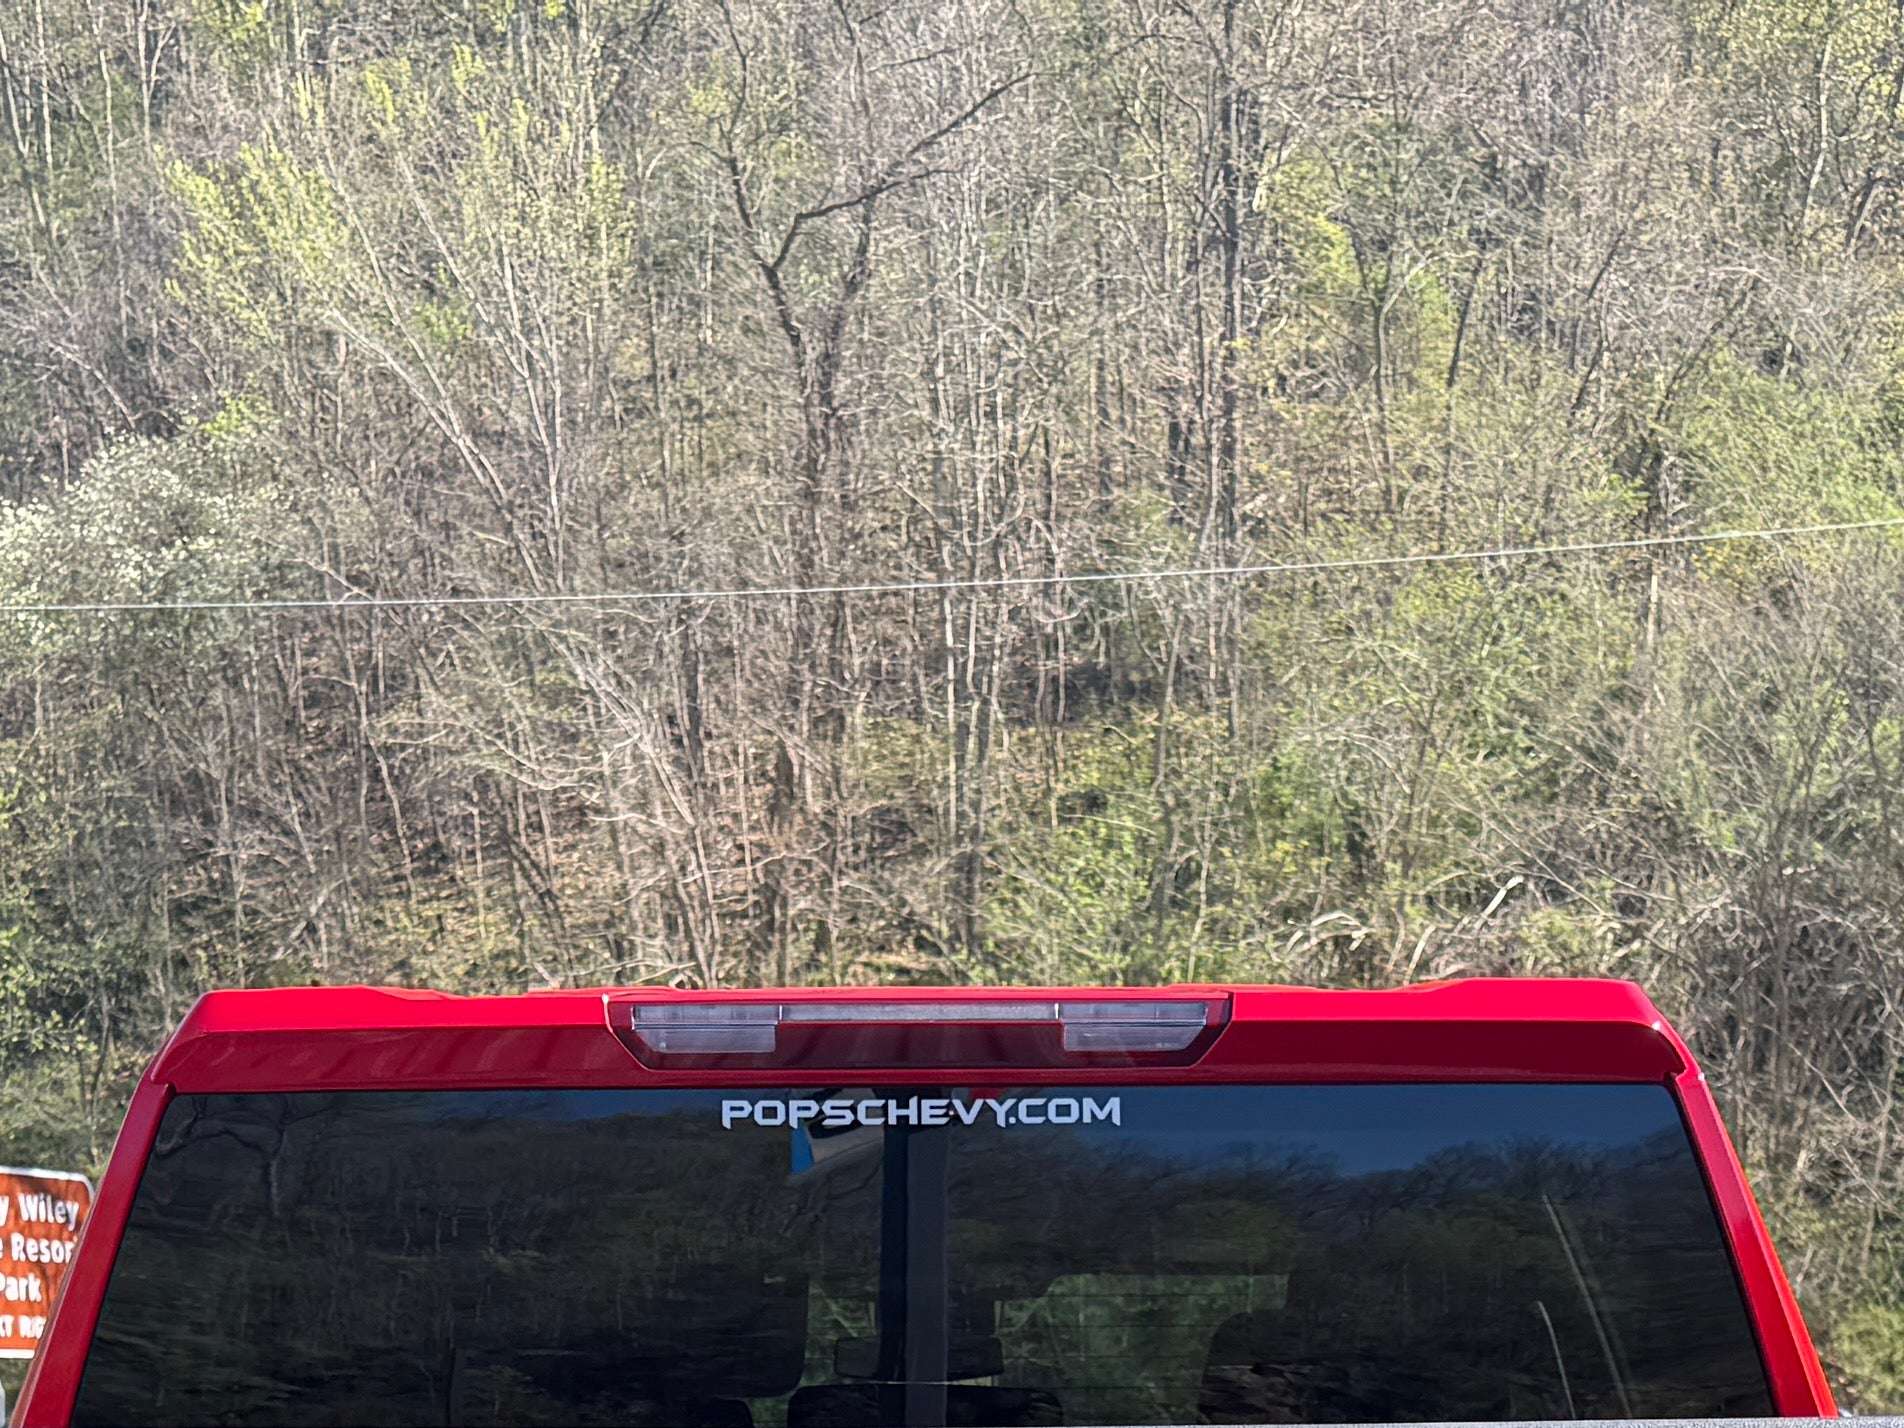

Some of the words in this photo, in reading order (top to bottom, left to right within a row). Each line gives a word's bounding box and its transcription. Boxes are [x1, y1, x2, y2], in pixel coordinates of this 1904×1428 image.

[721, 1096, 1121, 1130] POPSCHEVY.COM
[17, 1192, 79, 1232] Wiley
[10, 1232, 78, 1264] Resor
